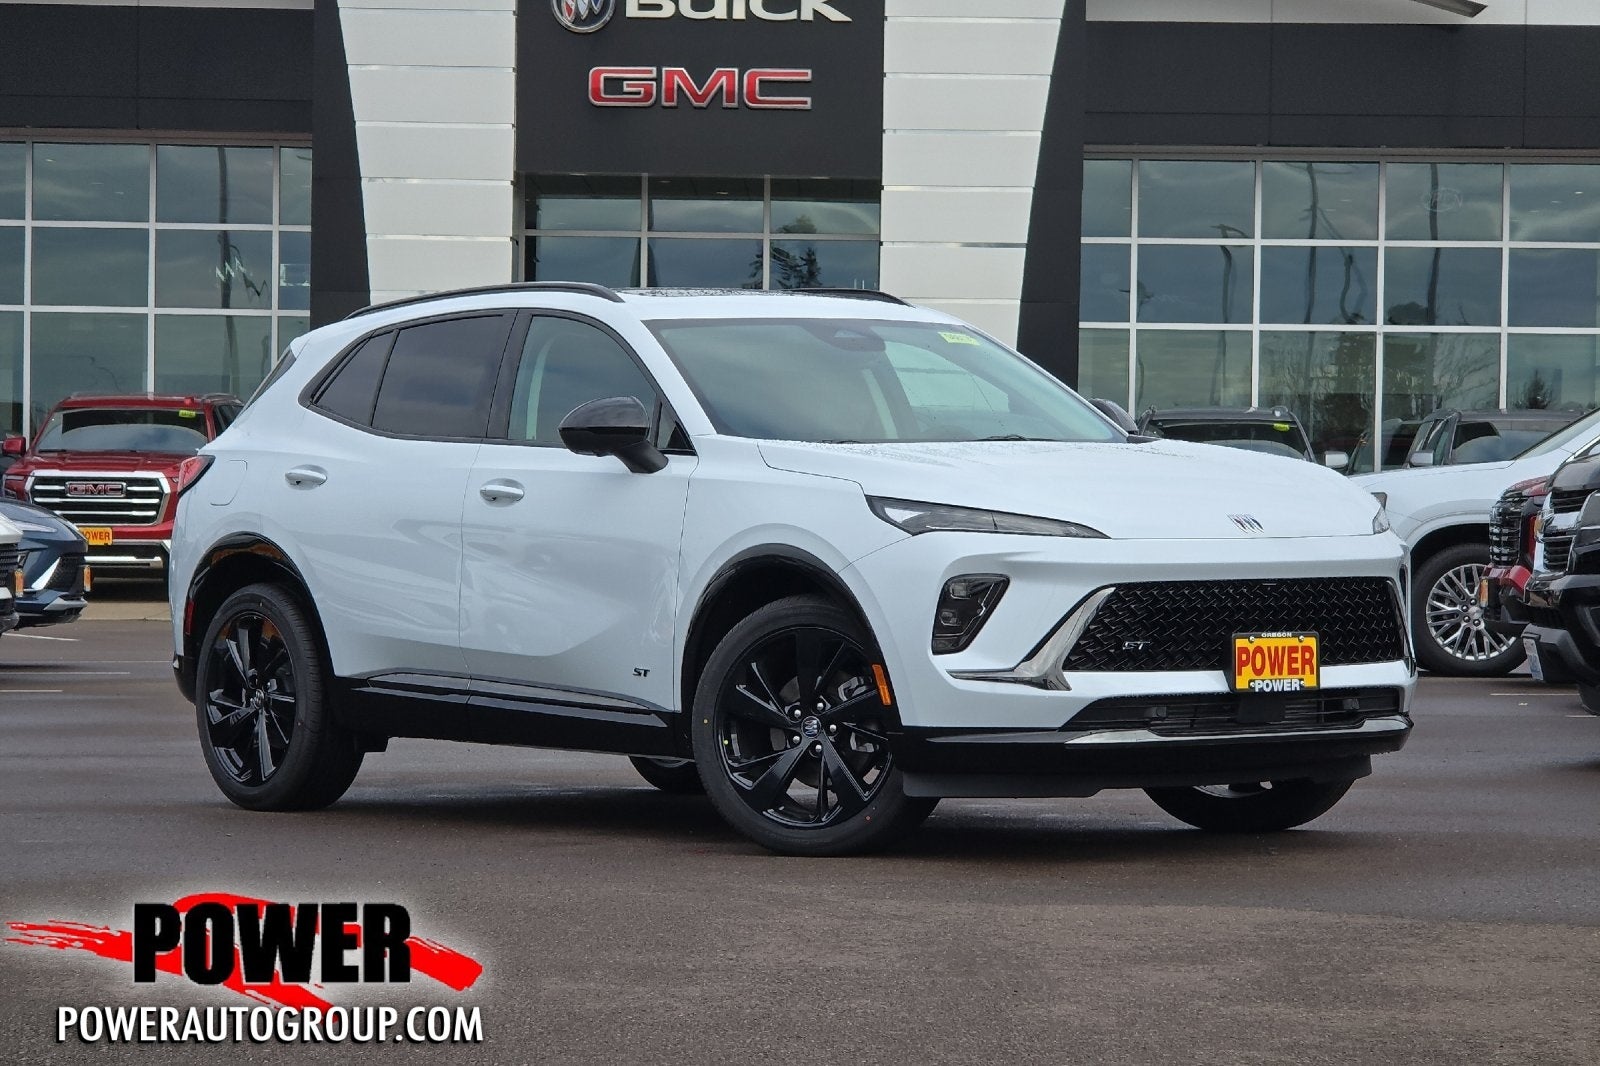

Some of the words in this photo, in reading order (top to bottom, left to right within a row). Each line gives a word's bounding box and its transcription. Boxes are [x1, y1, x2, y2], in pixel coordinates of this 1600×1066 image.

[588, 66, 812, 109] GMC
[70, 484, 122, 495] GMC
[83, 531, 110, 541] OWER
[1237, 645, 1315, 677] POWER
[632, 667, 651, 678] ST
[1254, 678, 1301, 692] POWER
